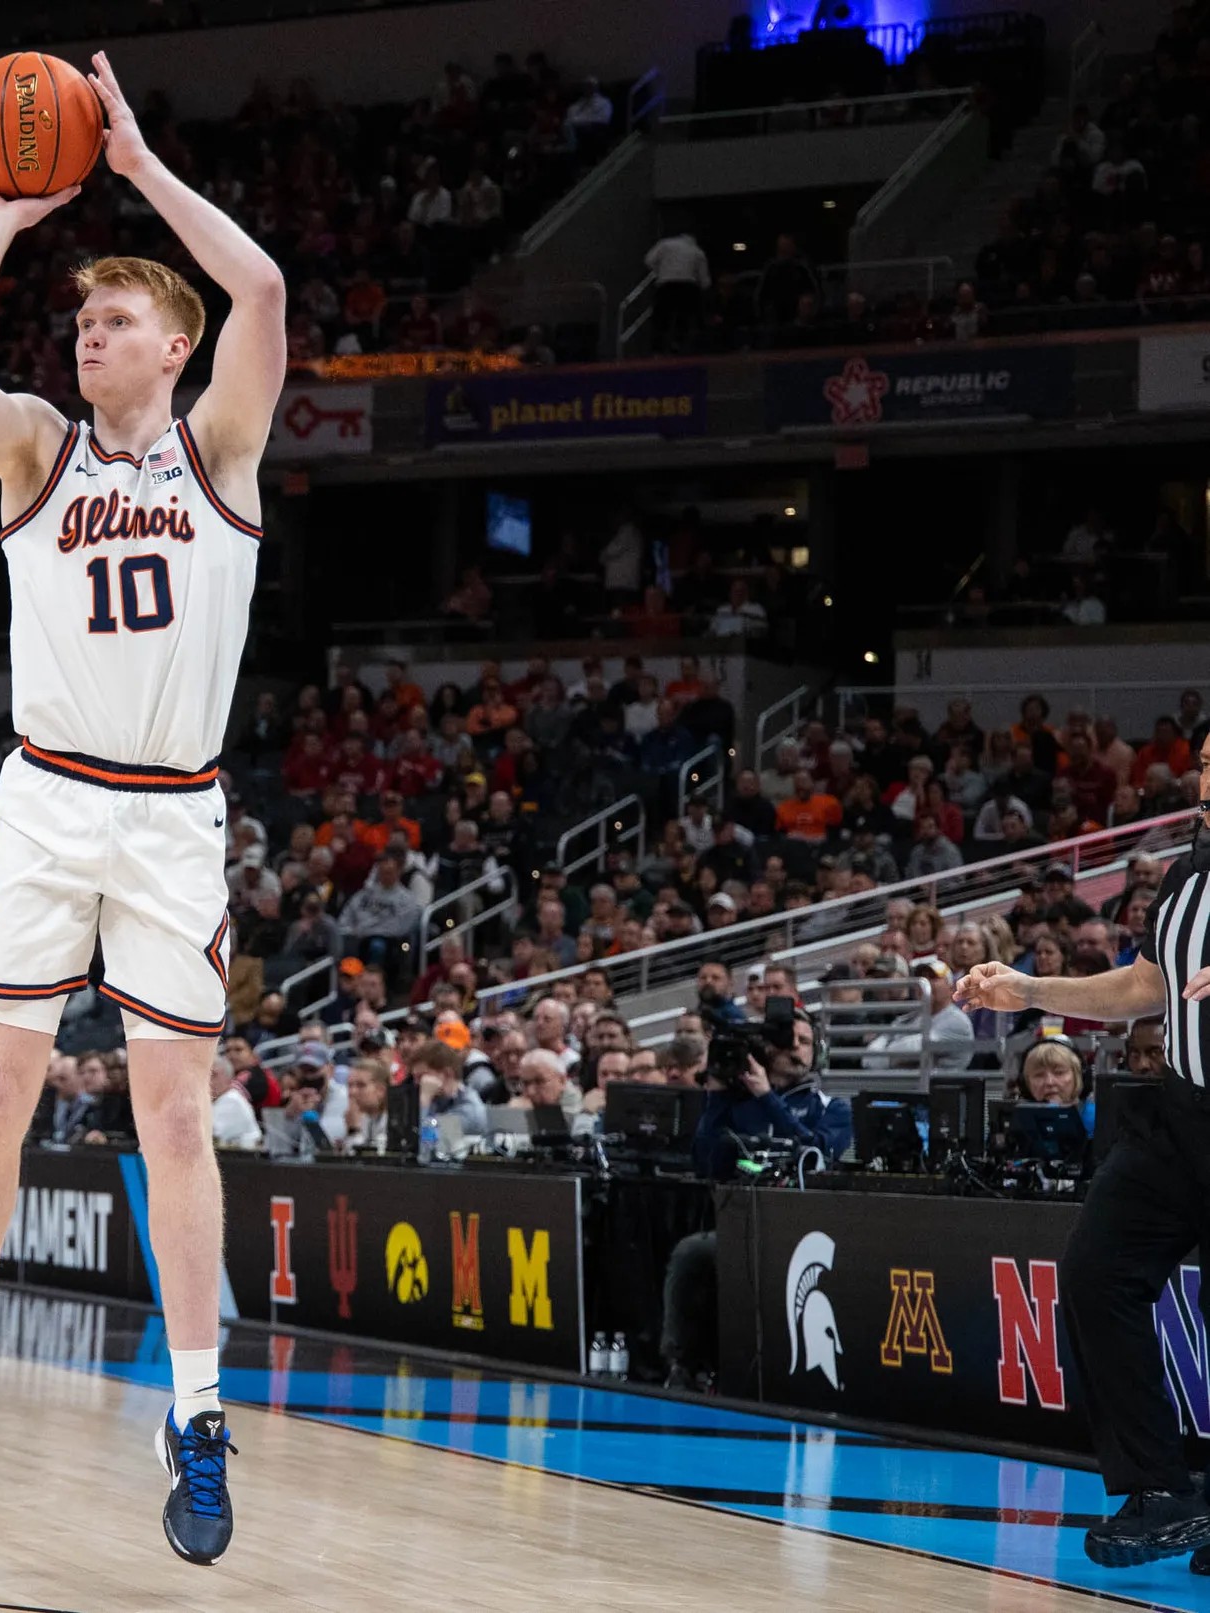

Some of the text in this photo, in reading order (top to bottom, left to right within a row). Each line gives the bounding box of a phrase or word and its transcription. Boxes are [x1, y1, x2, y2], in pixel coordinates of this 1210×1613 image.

[14, 72, 40, 172] SPALDING
[490, 398, 584, 433] planet
[591, 393, 693, 421] fitness
[894, 370, 1012, 396] REPUBLIC
[57, 488, 196, 555] Illinois
[86, 553, 176, 635] 10
[992, 1256, 1066, 1411] N
